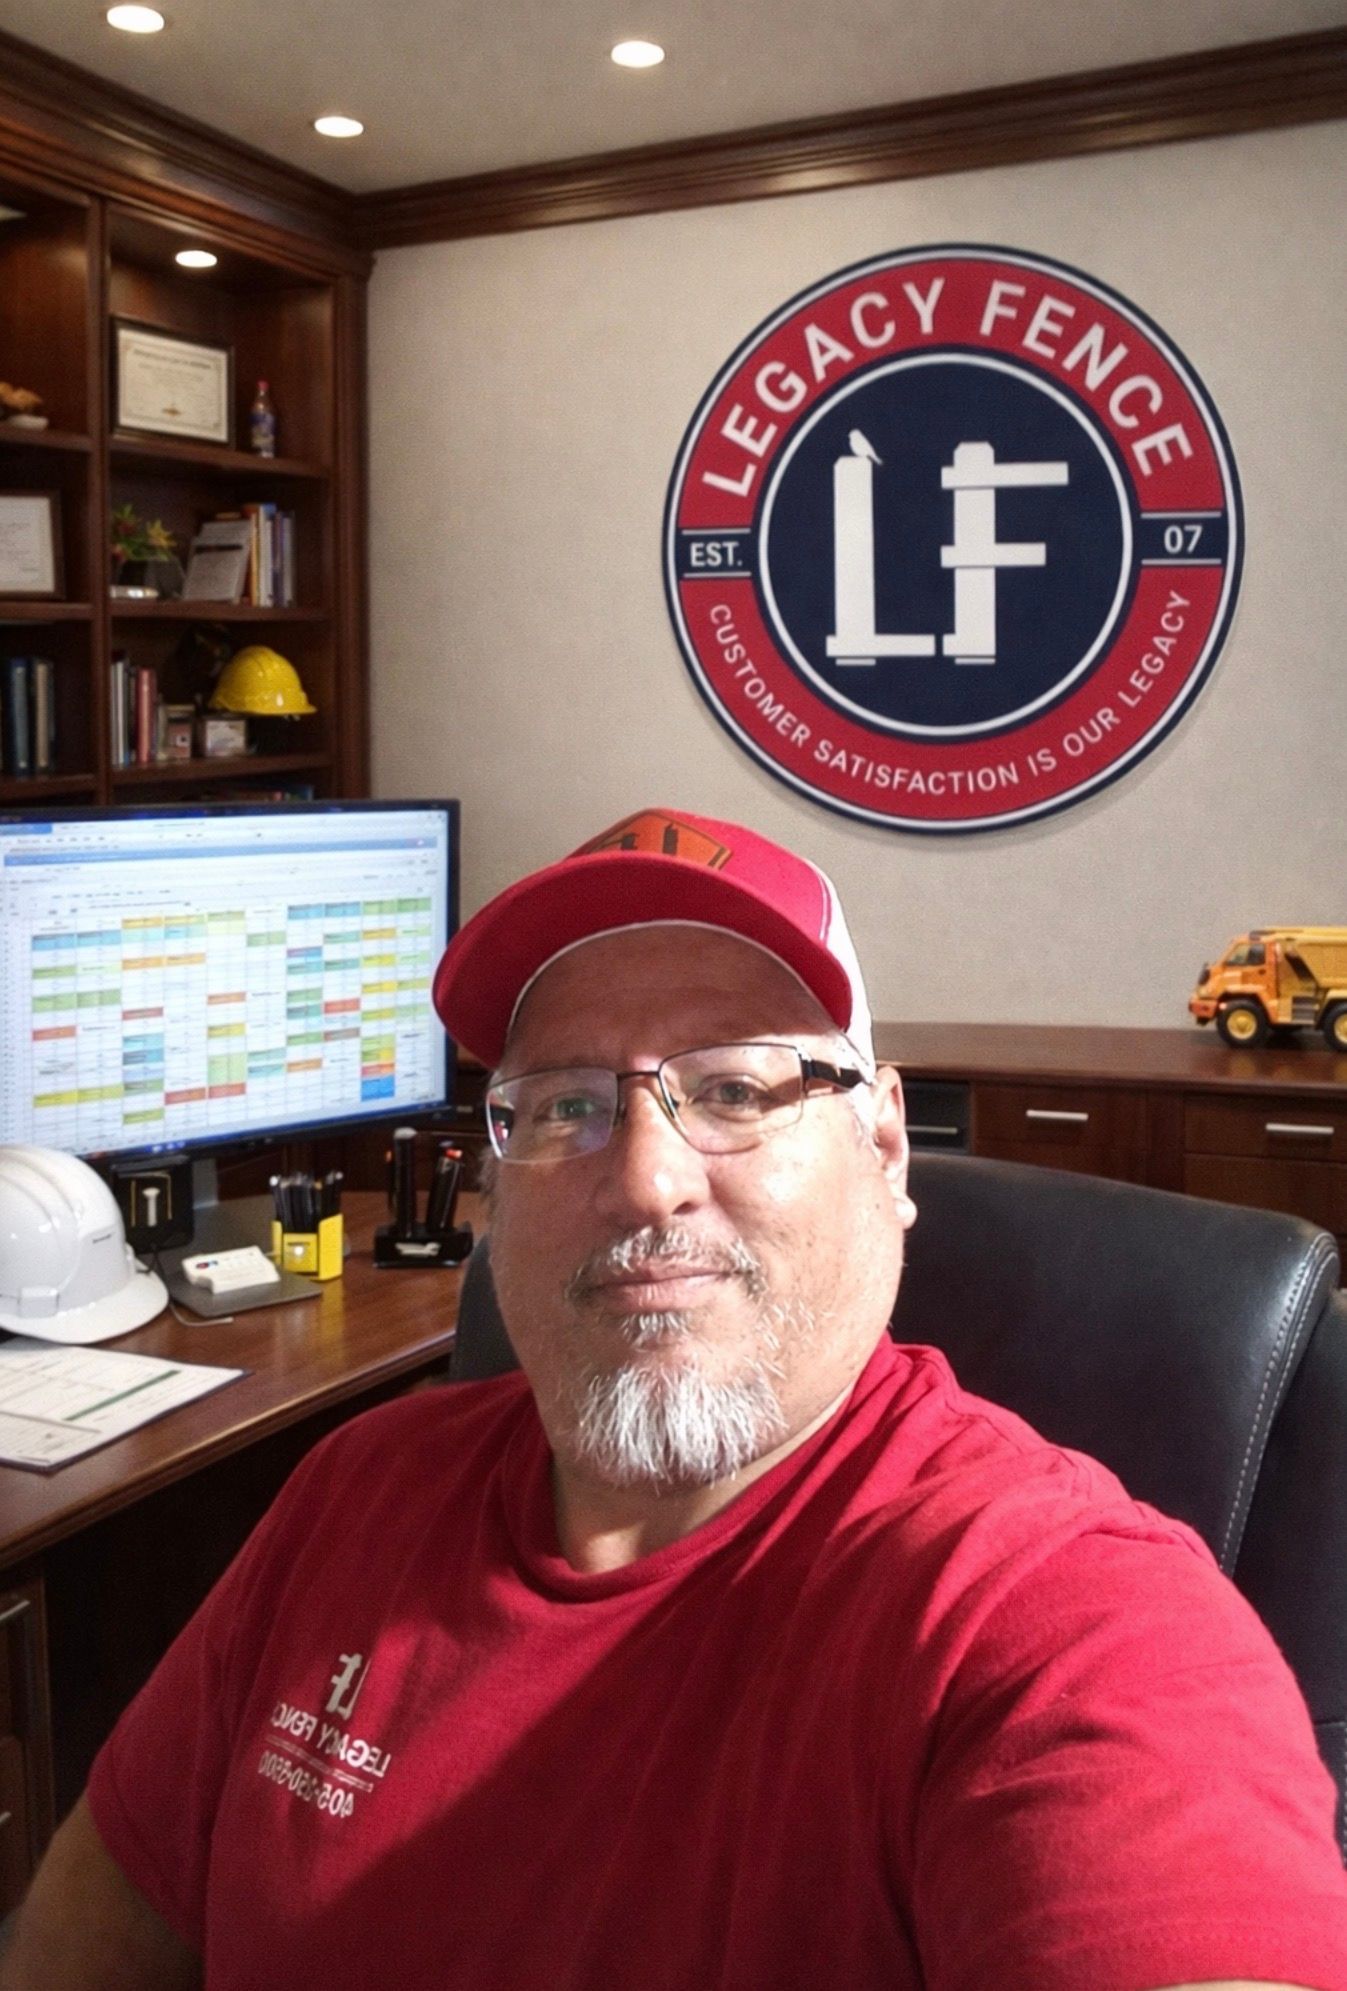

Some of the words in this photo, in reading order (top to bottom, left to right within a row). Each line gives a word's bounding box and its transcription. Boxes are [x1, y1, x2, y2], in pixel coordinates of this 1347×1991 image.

[702, 278, 946, 497] LEGACY
[979, 279, 1193, 476] FENCE
[690, 542, 742, 568] EST.
[826, 442, 1068, 666] LF
[1163, 524, 1202, 554] 07
[709, 604, 811, 747] CUSTOMER
[813, 739, 1019, 795] SATISFACTION
[1028, 748, 1056, 777] IS
[1063, 707, 1120, 758] OUR
[1121, 590, 1191, 708] LEGACY
